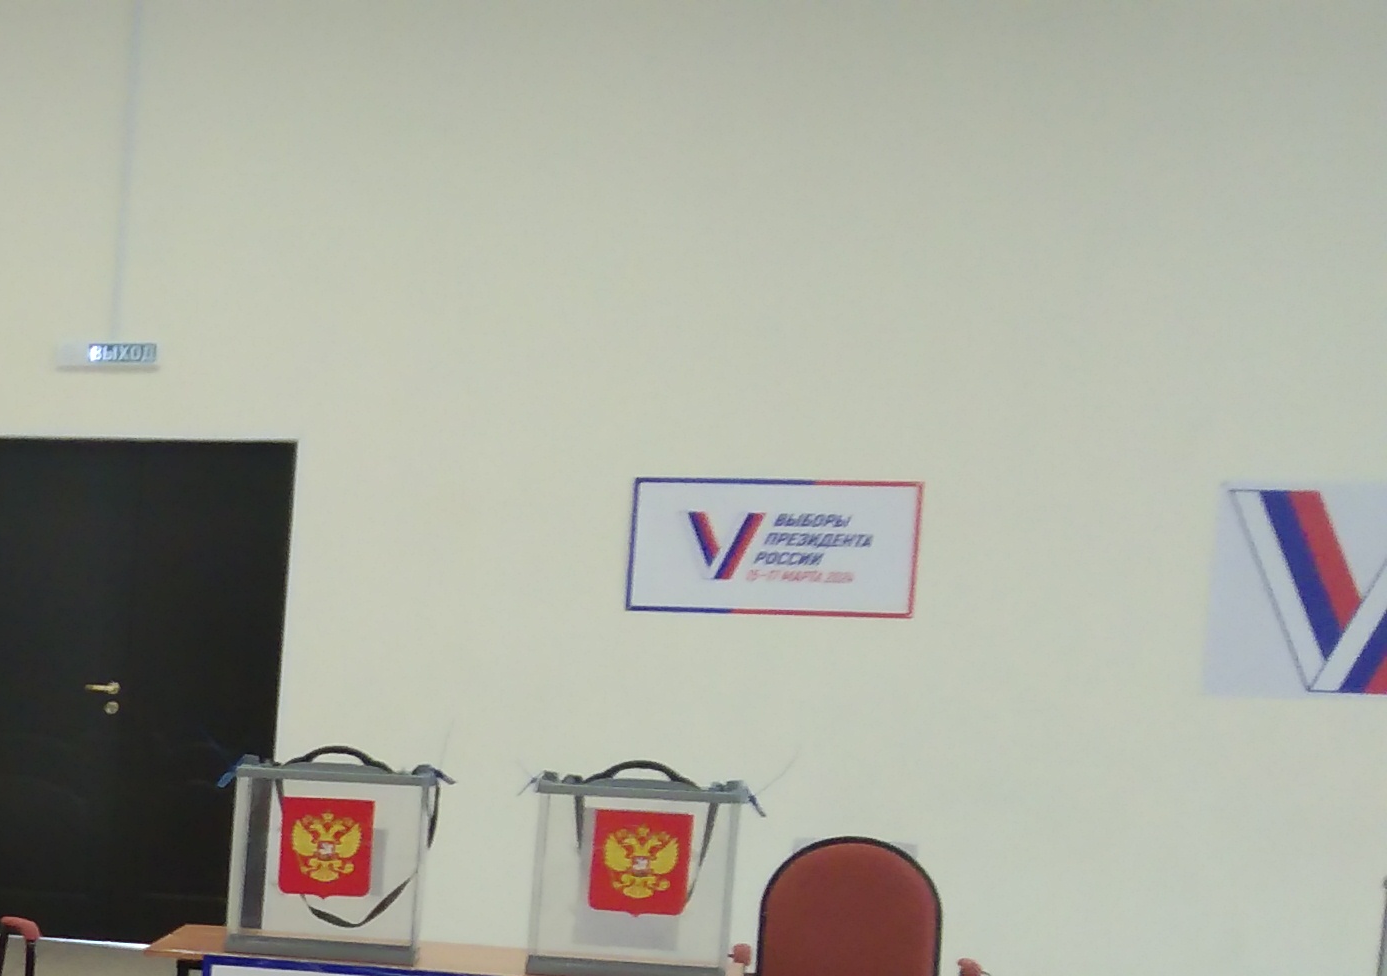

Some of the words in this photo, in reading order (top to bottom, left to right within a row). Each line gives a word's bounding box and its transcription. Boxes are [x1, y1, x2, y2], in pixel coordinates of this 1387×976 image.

[773, 512, 853, 528] ВЫБОРЫ
[763, 531, 874, 549] ПРЕЗИДЕНТА
[752, 550, 825, 566] РОССИИ
